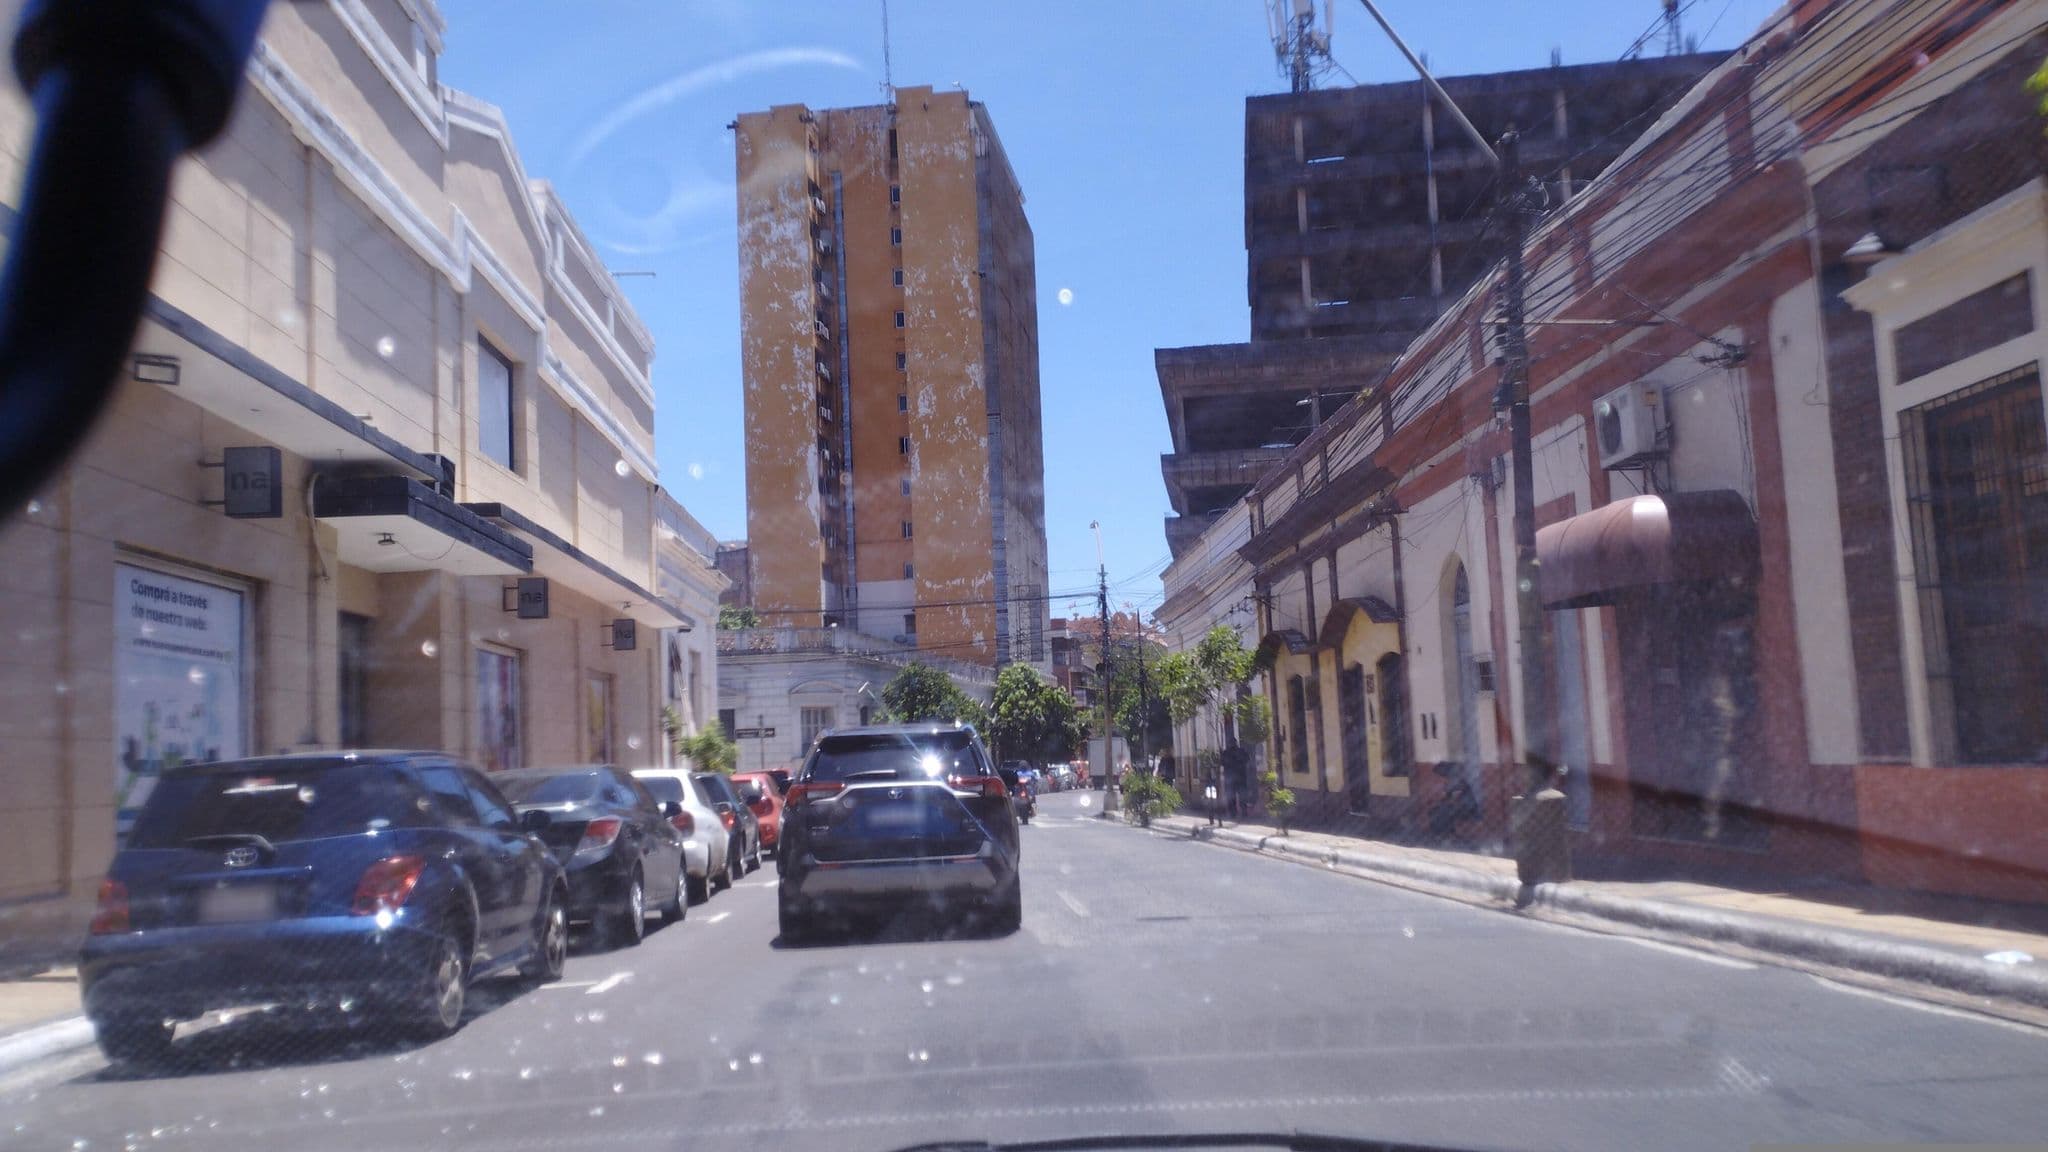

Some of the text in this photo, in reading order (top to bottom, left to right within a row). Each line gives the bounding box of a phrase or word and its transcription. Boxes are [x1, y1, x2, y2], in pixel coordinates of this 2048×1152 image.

[231, 470, 269, 490] na
[131, 579, 170, 603] Comprá
[520, 592, 543, 603] na
